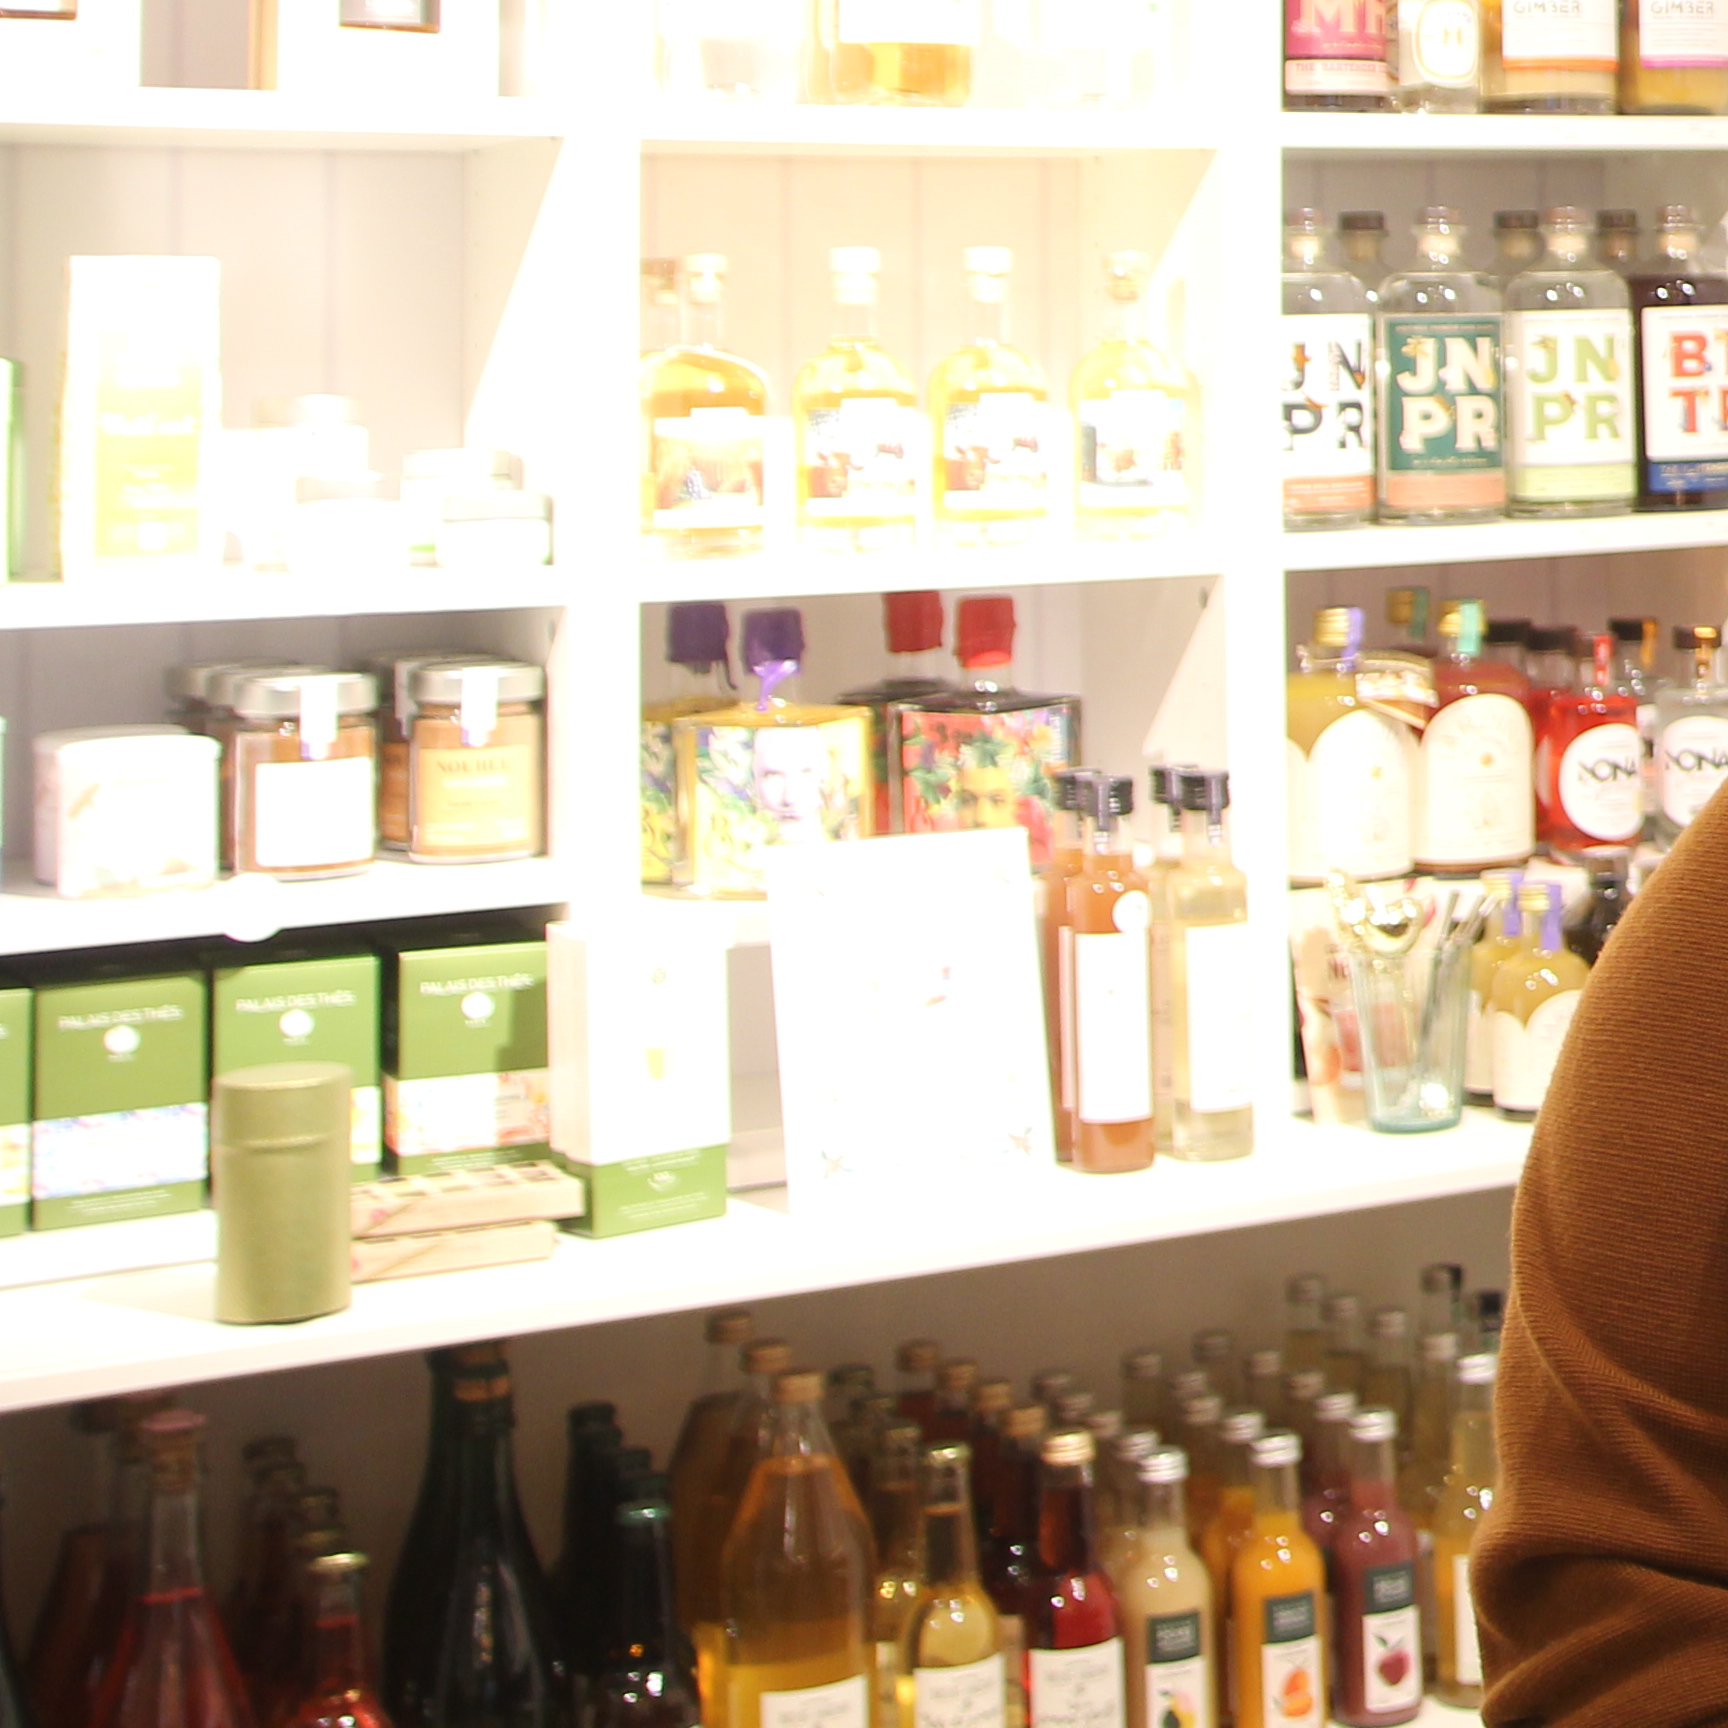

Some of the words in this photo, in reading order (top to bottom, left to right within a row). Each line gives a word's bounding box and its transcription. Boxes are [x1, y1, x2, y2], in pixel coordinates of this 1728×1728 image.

[1513, 0, 1581, 15] GIMBER
[1651, 0, 1715, 15] GIMBER
[1396, 335, 1498, 395] JN
[1525, 332, 1619, 383] JN
[1399, 394, 1499, 453] PR
[1526, 390, 1620, 441] PR
